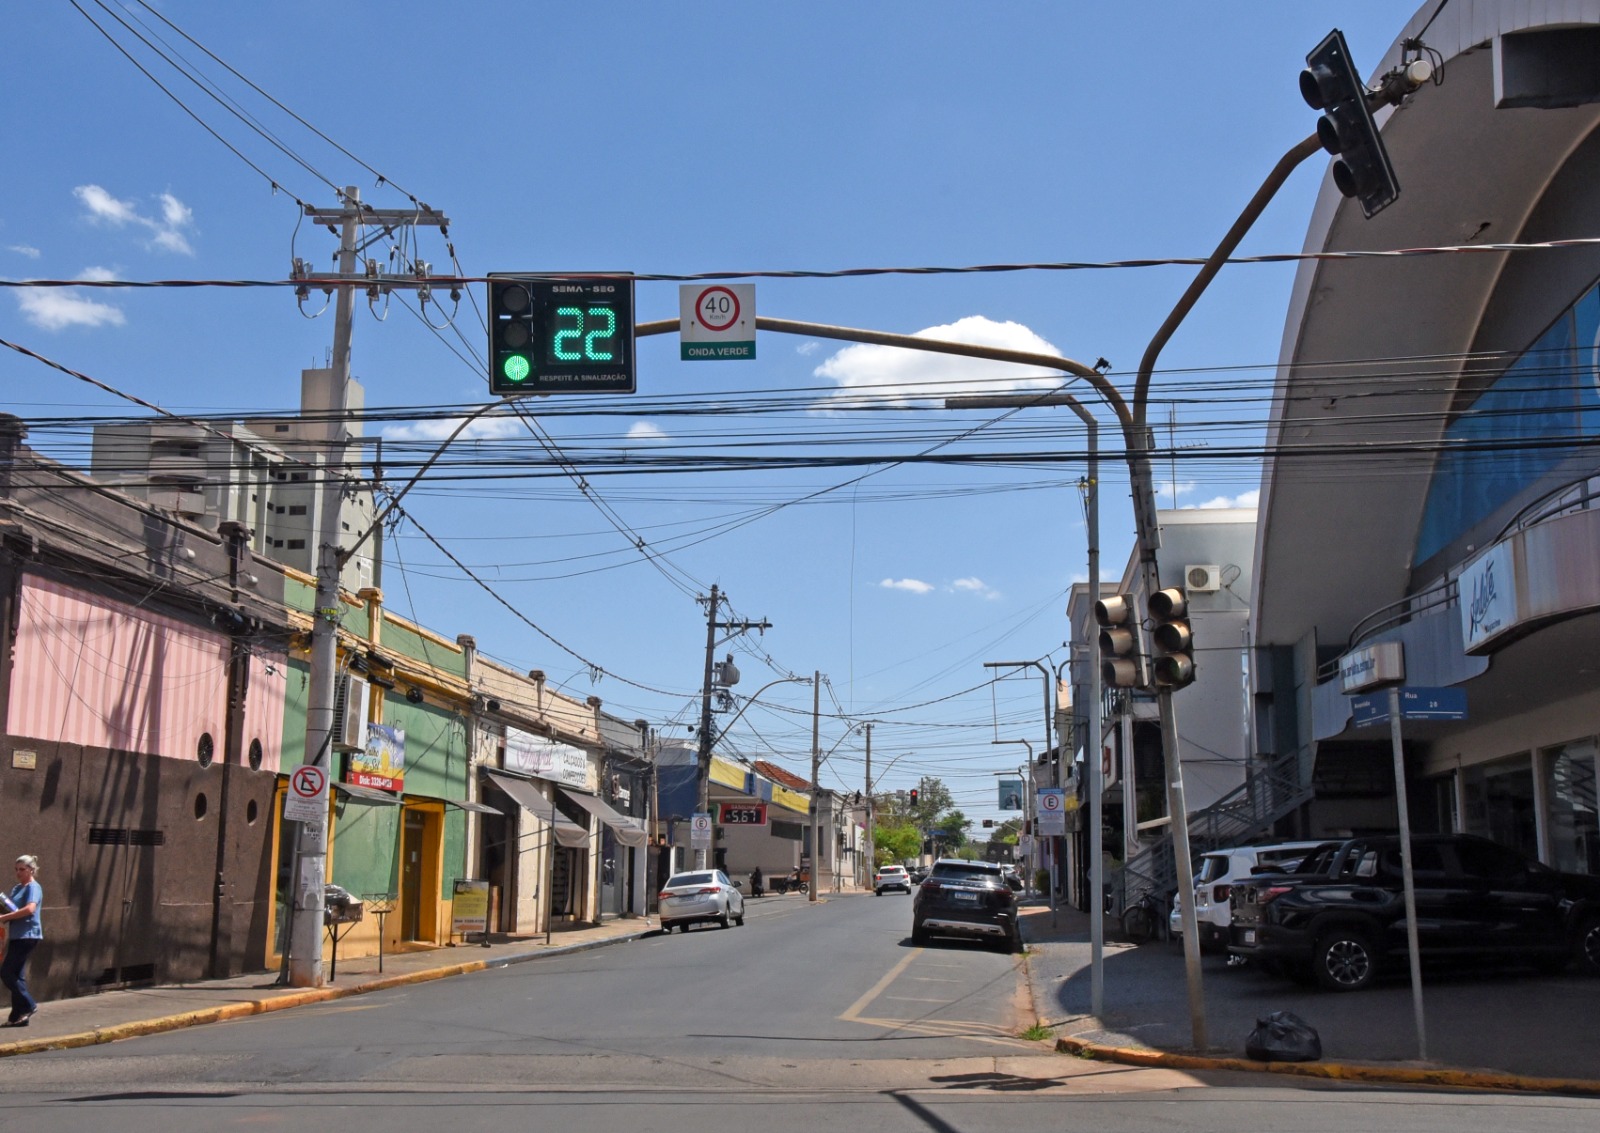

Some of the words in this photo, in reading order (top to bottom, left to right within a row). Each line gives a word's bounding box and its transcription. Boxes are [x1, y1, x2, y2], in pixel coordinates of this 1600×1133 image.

[552, 285, 583, 293] SEMA
[593, 285, 615, 293] SEG
[705, 296, 730, 314] 40
[554, 307, 616, 361] 22
[688, 347, 716, 357] ONDA
[717, 346, 749, 356] VERDE
[581, 373, 627, 382] SINALIZAÇÃO
[563, 753, 582, 768] CALÇADOS
[1048, 798, 1054, 807] E
[699, 820, 704, 828] E
